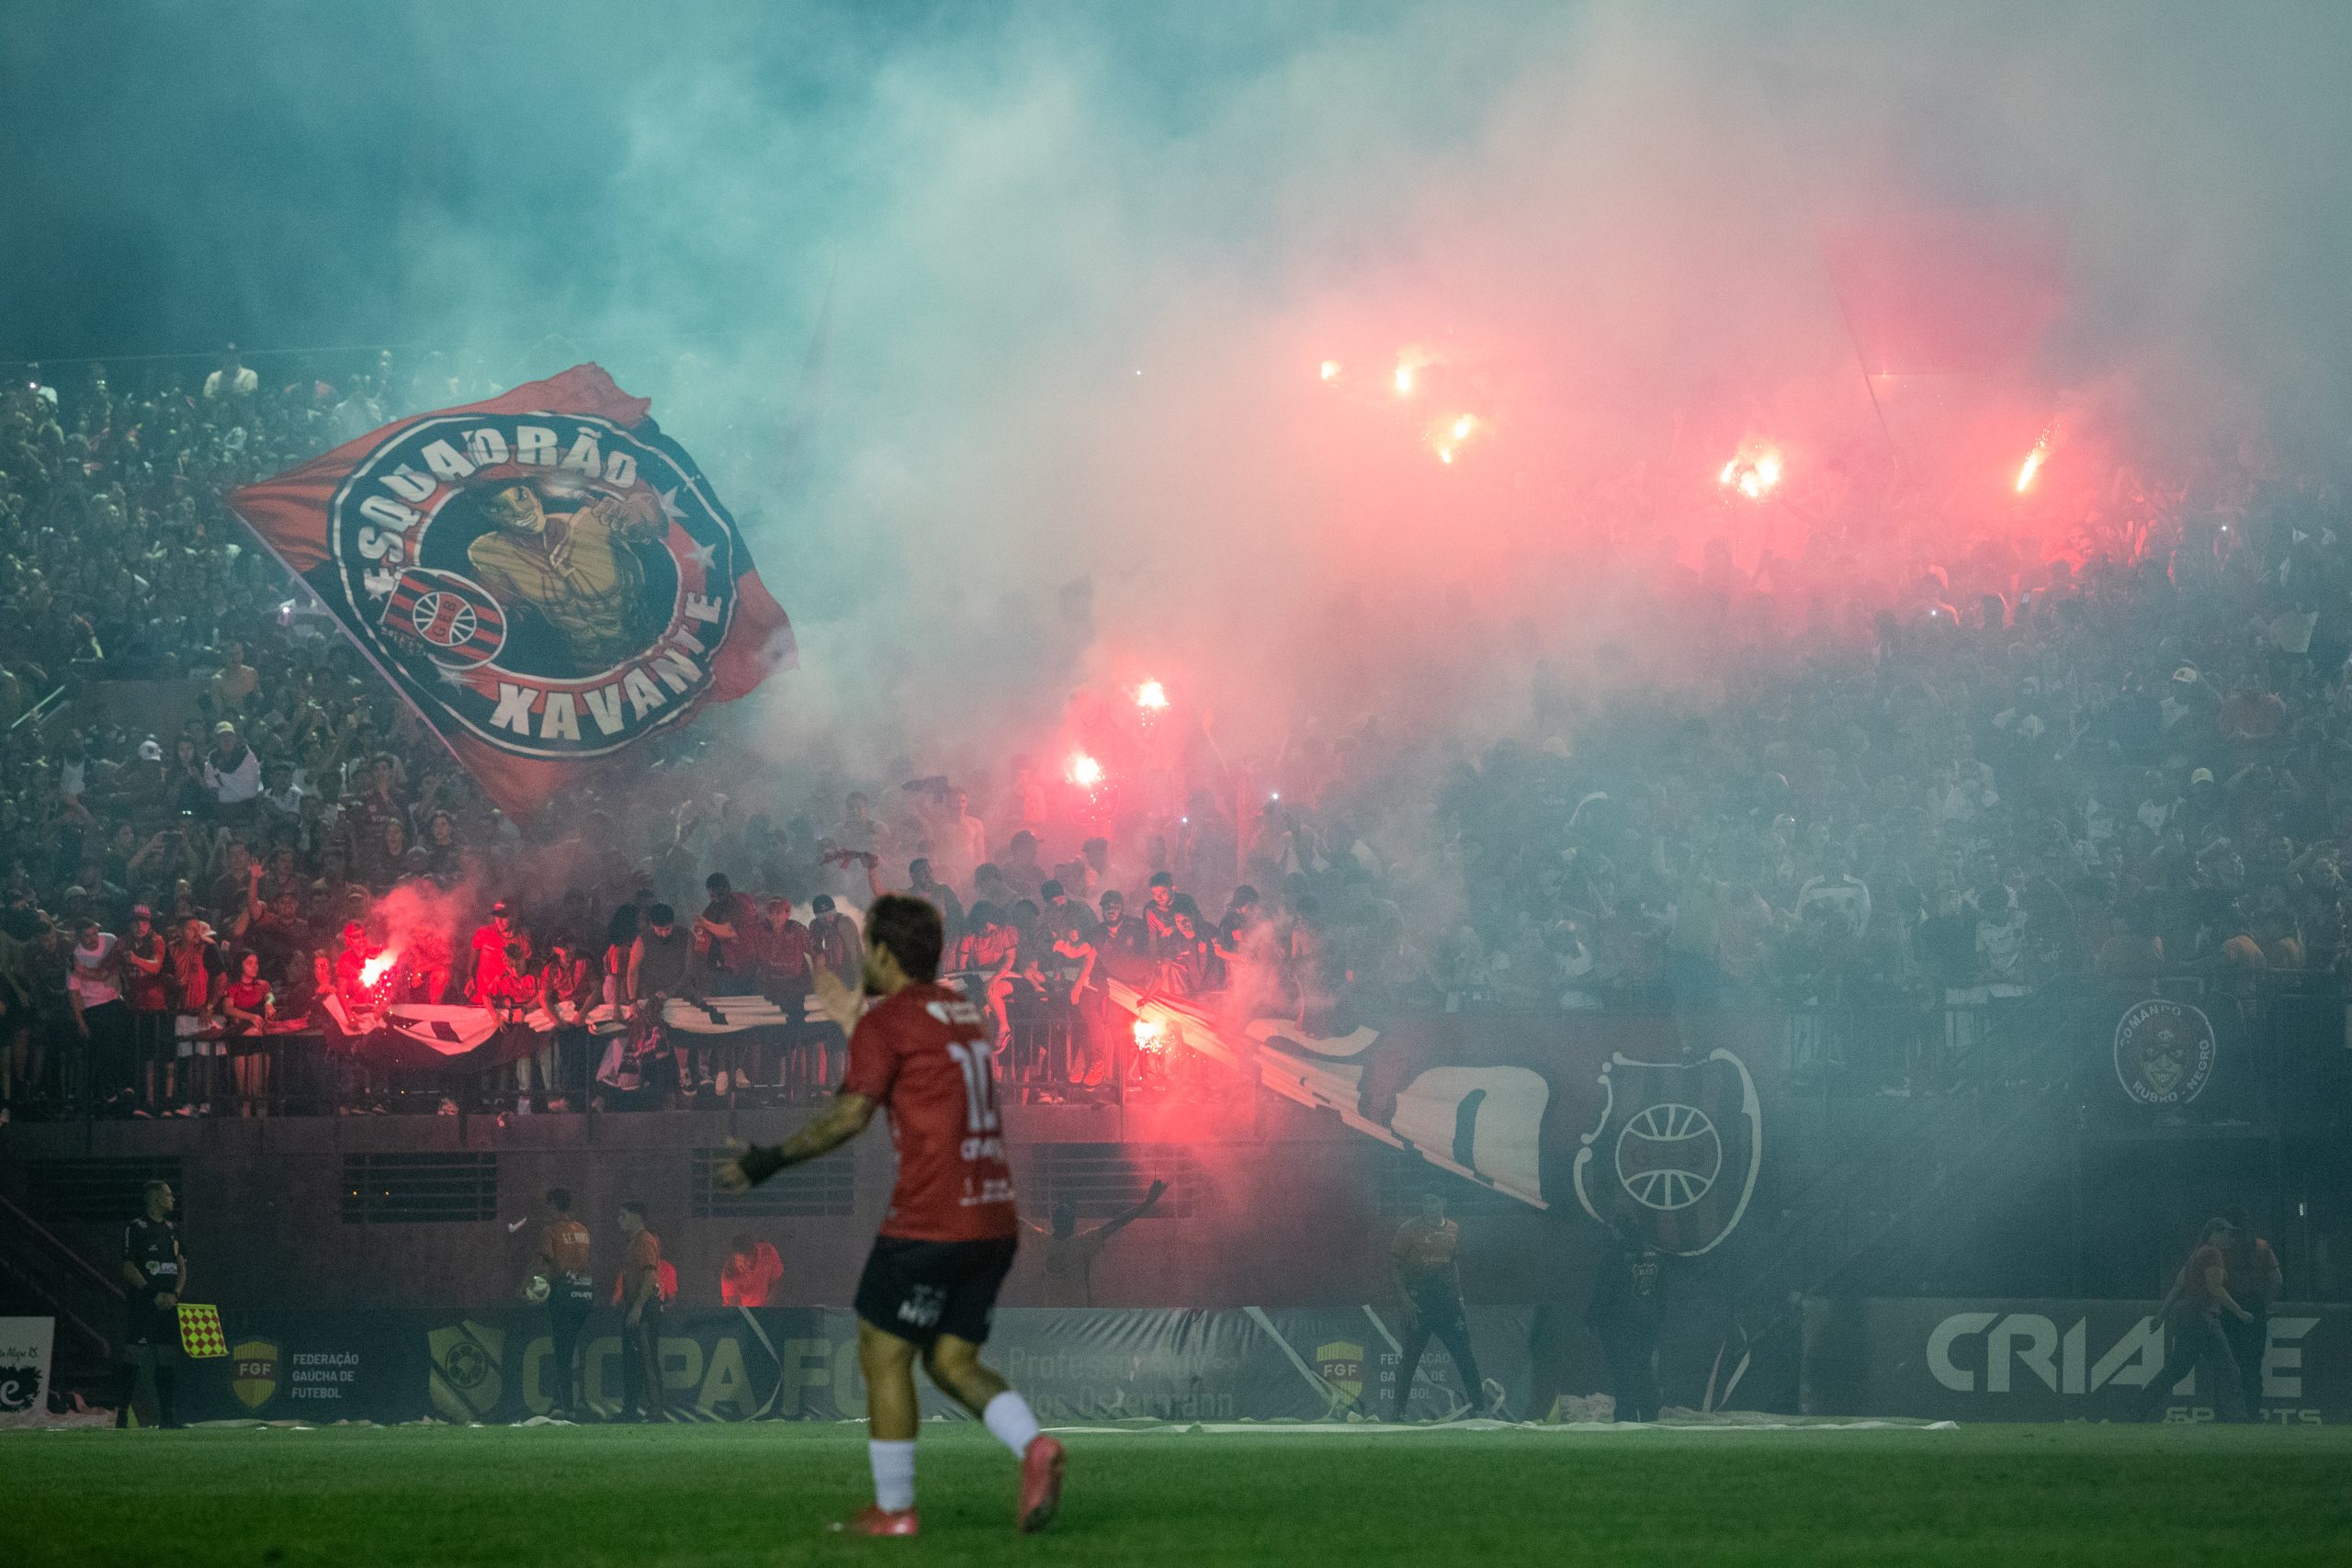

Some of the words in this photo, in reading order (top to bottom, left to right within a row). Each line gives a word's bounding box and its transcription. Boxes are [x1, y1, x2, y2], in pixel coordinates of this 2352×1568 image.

[358, 424, 638, 593] ESQUADRÃO
[432, 600, 458, 637] GEB
[490, 591, 724, 740] XAVANTE
[2132, 1080, 2178, 1103] RUBRO
[2187, 1039, 2210, 1090] NEGRO
[293, 1351, 359, 1367] FEDERAÇÃO
[1009, 1346, 1145, 1381] Professo
[1380, 1351, 1451, 1367] FEDAÇÃO
[1926, 1312, 2322, 1398] CRIAE
[239, 1362, 272, 1376] FGF
[292, 1368, 337, 1382] GAÚCHA
[340, 1371, 355, 1382] DE
[781, 1336, 867, 1417] FG
[1323, 1363, 1358, 1378] FGF
[291, 1387, 342, 1400] FUTEBOL
[1380, 1388, 1433, 1401] FUBOL
[2164, 1405, 2323, 1426] SPTS
